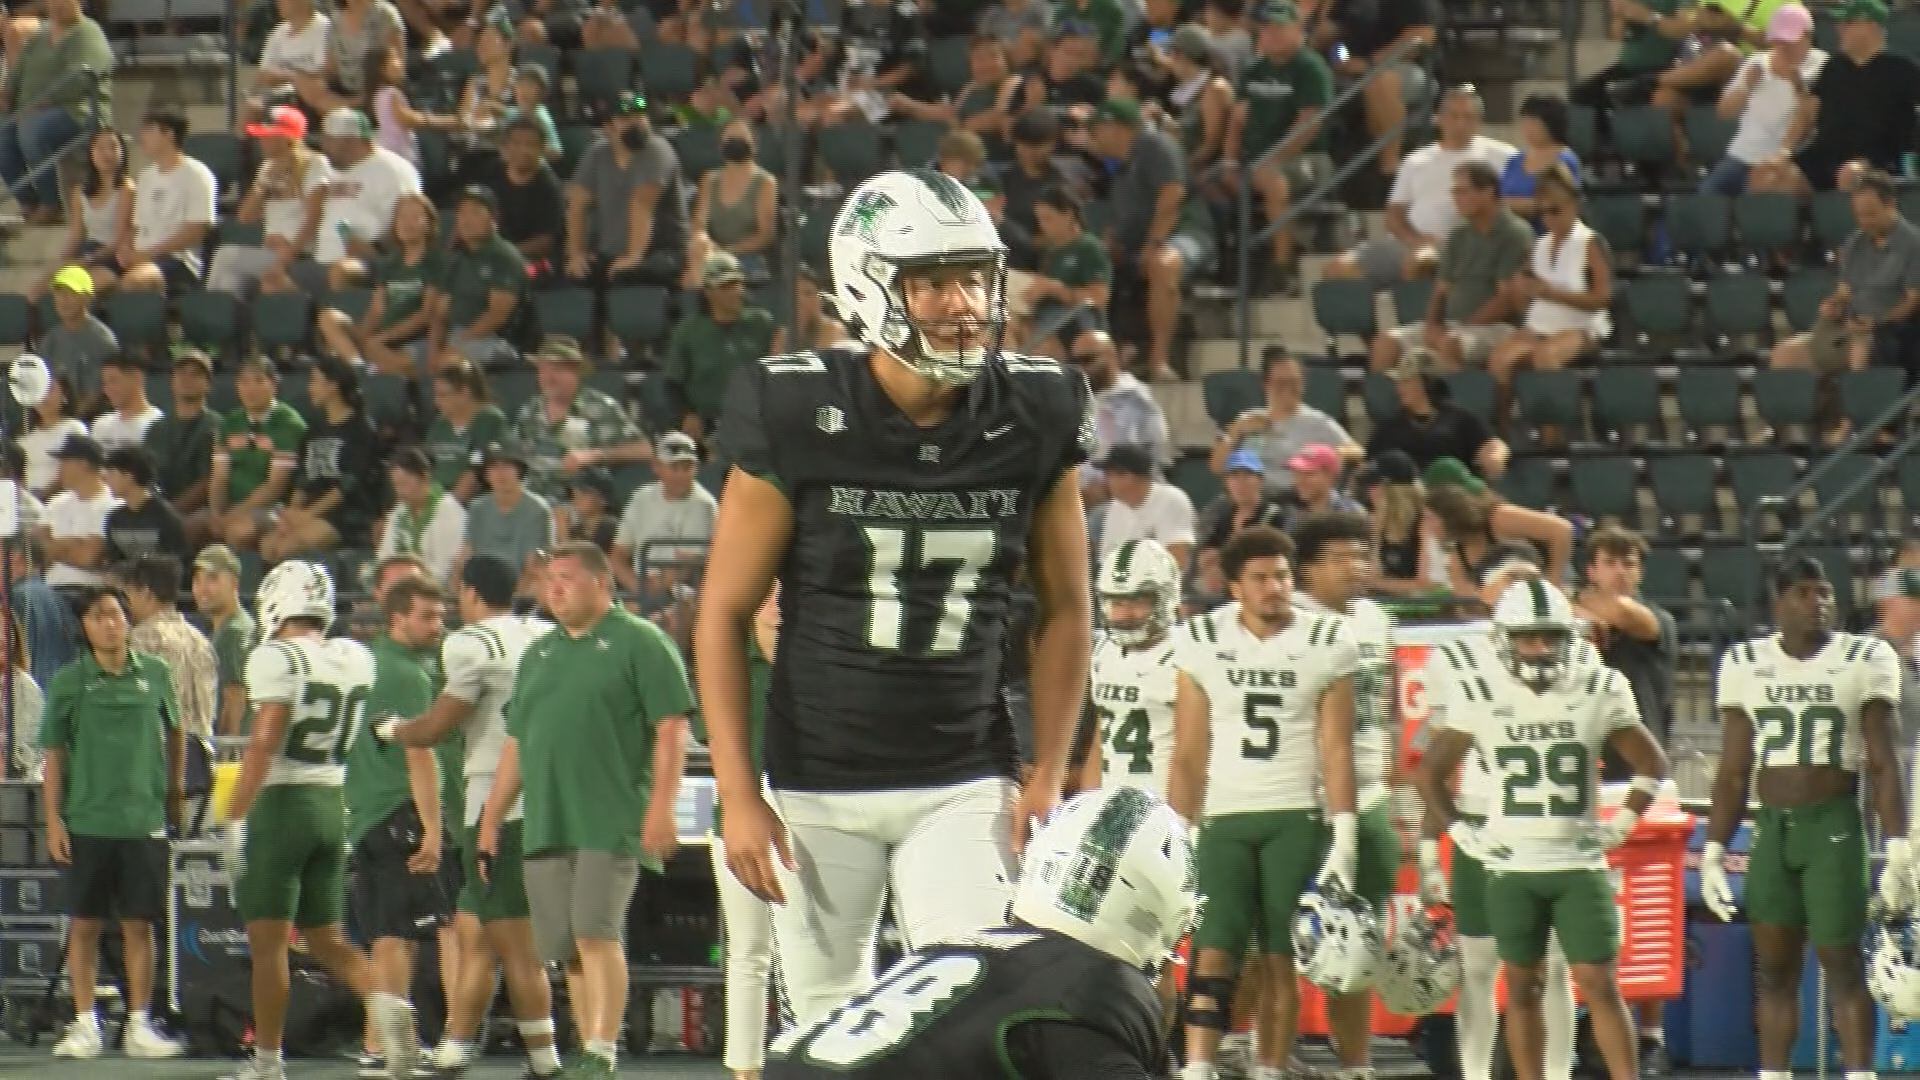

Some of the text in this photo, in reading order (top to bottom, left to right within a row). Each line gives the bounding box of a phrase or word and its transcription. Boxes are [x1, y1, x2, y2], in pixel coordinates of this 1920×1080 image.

[864, 527, 996, 651] 17
[1227, 668, 1297, 687] VIKS
[1765, 684, 1834, 703] VIKS
[1241, 693, 1284, 760] 5
[1504, 721, 1576, 742] VIKS
[1753, 705, 1847, 769] 20
[1495, 741, 1590, 817] 29
